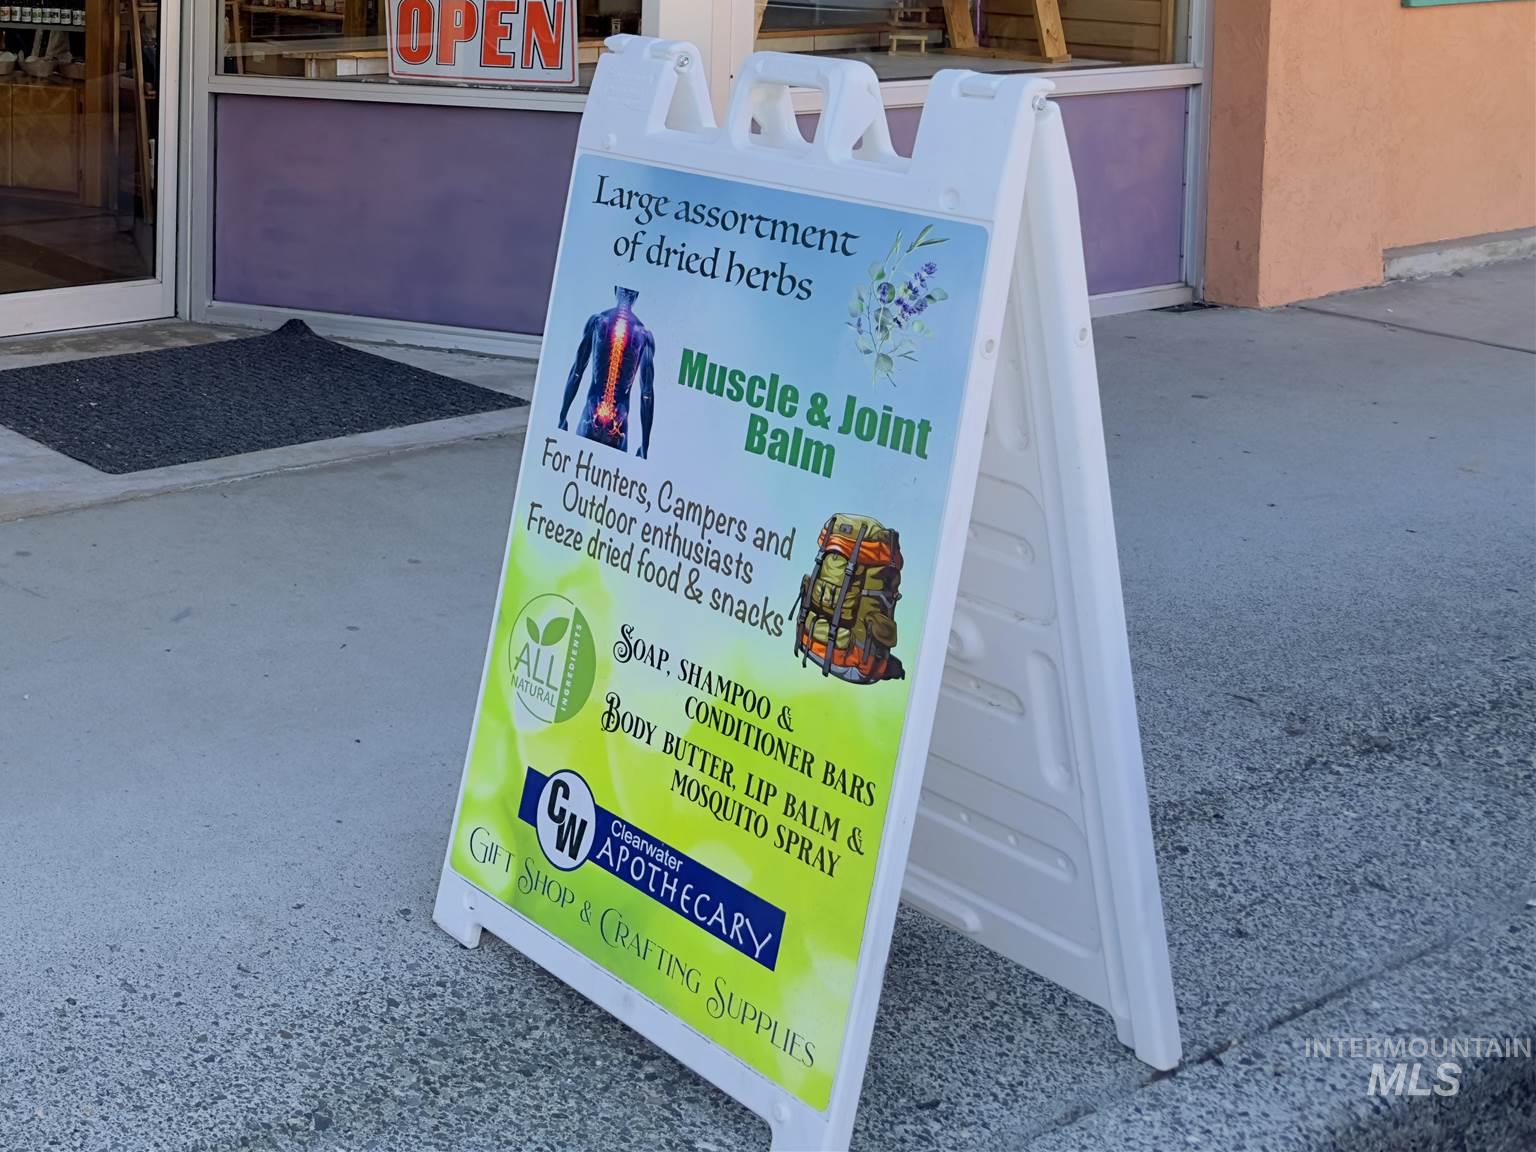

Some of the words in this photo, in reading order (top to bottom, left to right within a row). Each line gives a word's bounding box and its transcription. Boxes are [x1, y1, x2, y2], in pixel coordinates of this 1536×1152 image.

[592, 174, 669, 226] Large
[676, 198, 860, 257] assortment
[613, 230, 647, 262] of
[645, 235, 719, 280] dried
[725, 250, 813, 301] herbs
[678, 348, 799, 420] Muscle
[806, 392, 832, 430] &
[838, 395, 932, 461] Joint
[744, 413, 835, 479] Balm
[542, 437, 571, 475] For
[575, 450, 652, 513] Hunters,
[658, 480, 747, 545] Campers
[753, 525, 796, 561] and
[562, 481, 637, 536] Outdoor
[641, 521, 754, 586] enthusiasts
[527, 502, 583, 552] Freeze
[587, 530, 632, 575] dried
[637, 547, 681, 595] food
[684, 570, 704, 606] &
[709, 583, 785, 639] snacks
[509, 673, 556, 709] NATURAL
[513, 640, 558, 692] ALL
[560, 622, 583, 712] INGREDIENTS
[613, 623, 671, 677] SOAP,
[677, 660, 772, 721] SHAMPOO
[777, 703, 795, 733] &
[600, 692, 657, 748] BODY
[663, 732, 737, 792] BUTTER,
[745, 770, 777, 808] LIP
[784, 791, 841, 842] BALM
[847, 825, 865, 857] &
[683, 695, 818, 781] CONDITIONER
[822, 761, 876, 807] BARS
[611, 819, 684, 874] Clearwater
[670, 769, 770, 840] MOSQUITO
[774, 825, 841, 878] SPRAY
[579, 901, 592, 927] &
[596, 840, 774, 961] APOTHECARY
